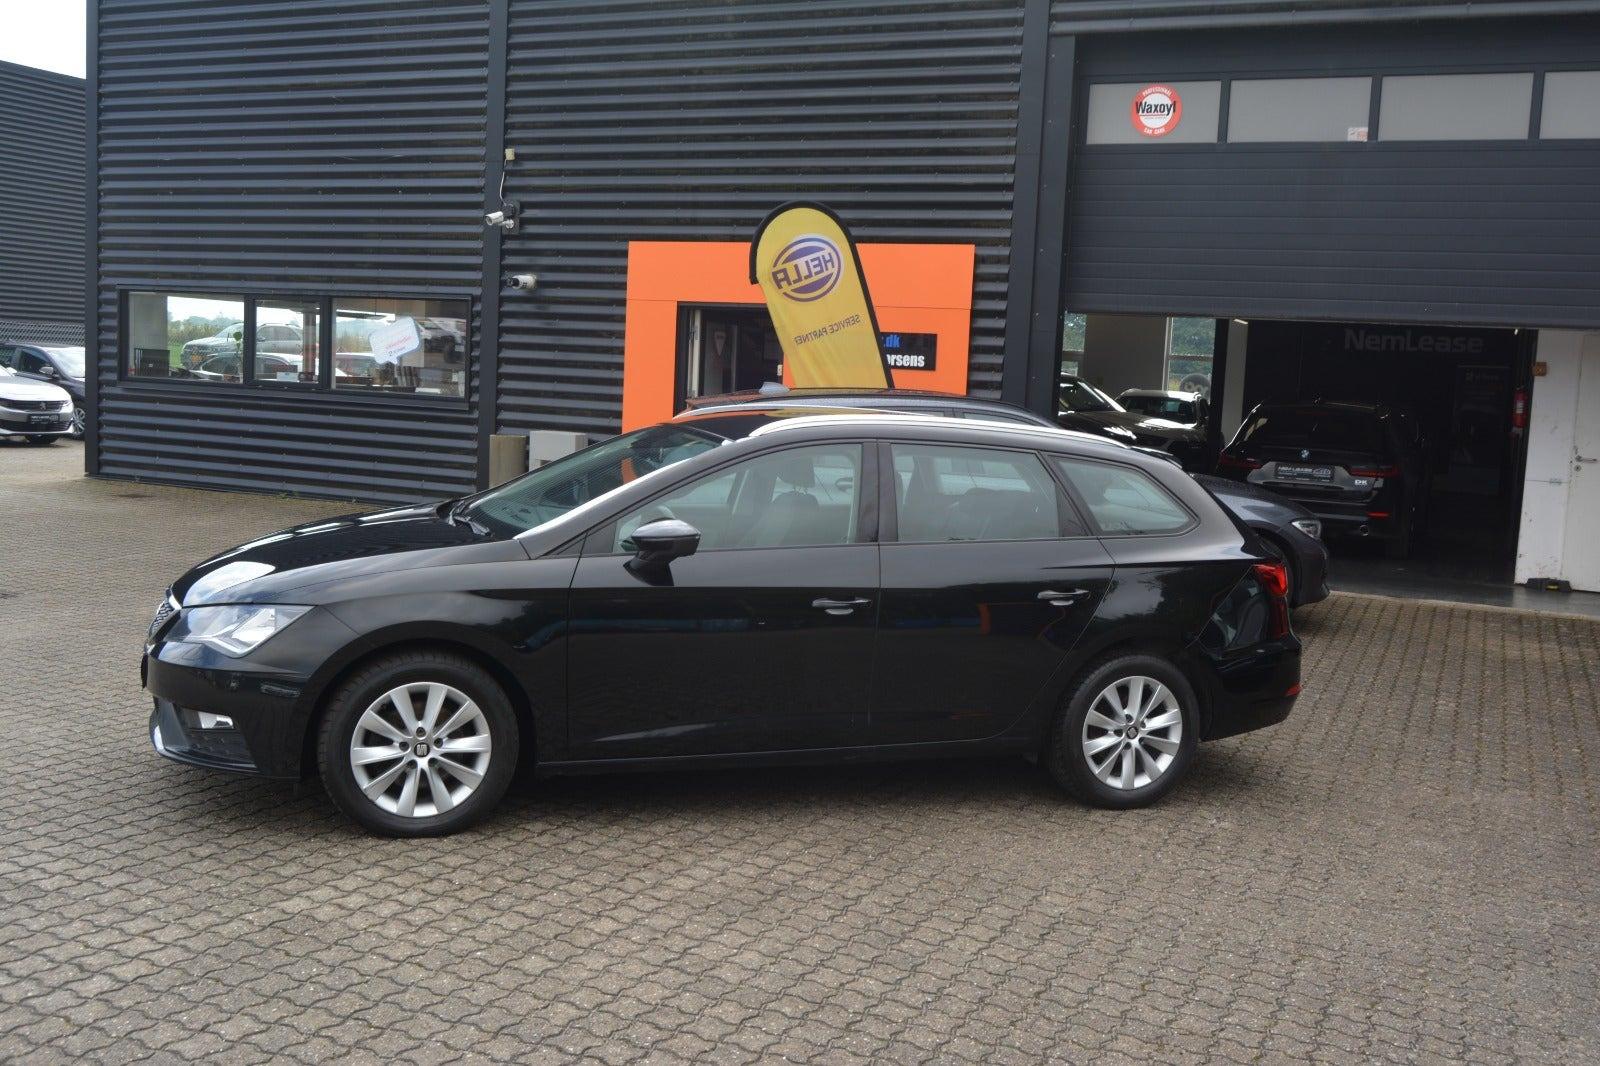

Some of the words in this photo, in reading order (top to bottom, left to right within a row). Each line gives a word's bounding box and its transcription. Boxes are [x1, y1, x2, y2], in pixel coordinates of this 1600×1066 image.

[1135, 100, 1177, 116] Waxoyl
[882, 334, 900, 348] .dk
[1344, 328, 1484, 353] NemLease
